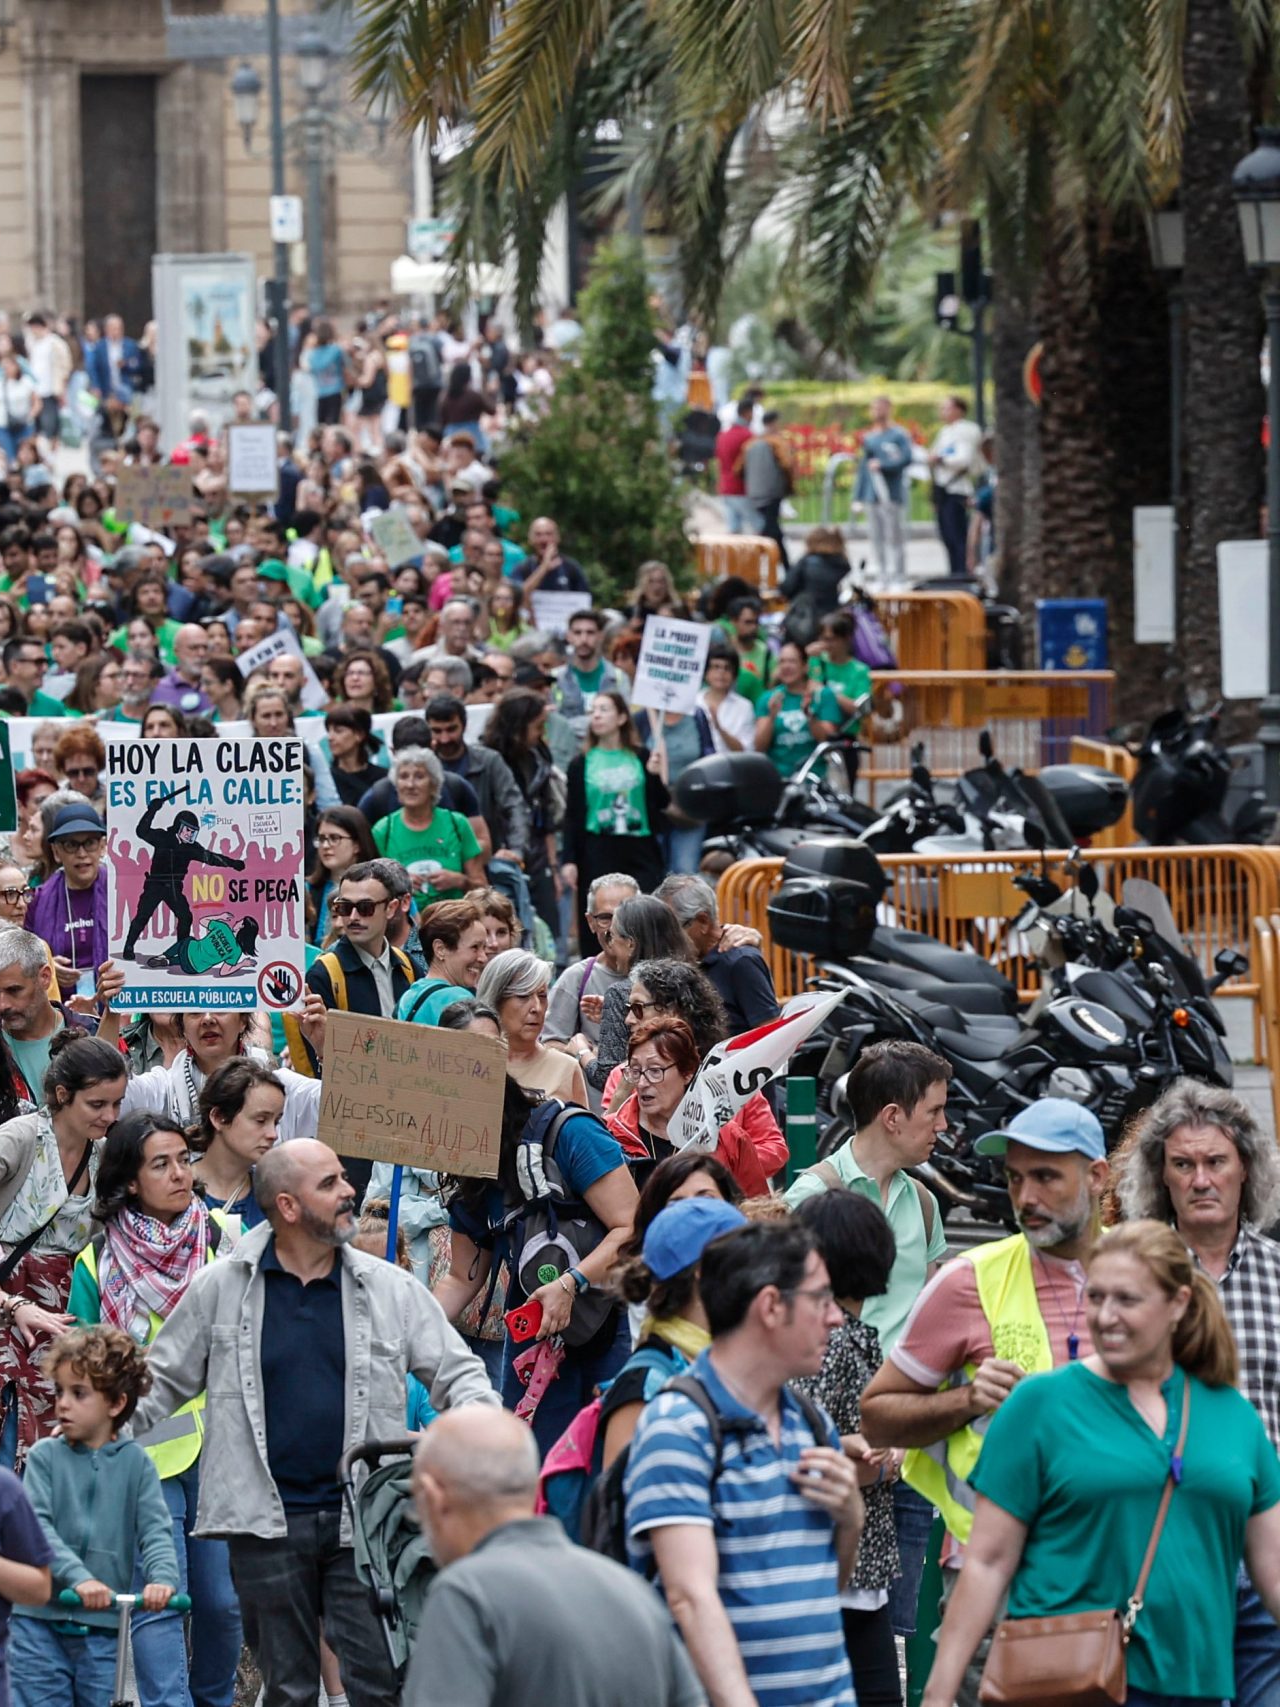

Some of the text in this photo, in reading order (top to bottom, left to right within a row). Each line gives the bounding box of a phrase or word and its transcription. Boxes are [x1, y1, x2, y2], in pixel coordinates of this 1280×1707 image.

[108, 741, 302, 776] HOY LA CLASE
[109, 778, 302, 808] ES EN LA CALLE:
[192, 873, 300, 903] NO SE PEGA
[111, 988, 243, 1005] POR LA ESCUELA PÚBLICA
[332, 1024, 491, 1081] LA MEUA MESTRA
[322, 1091, 489, 1157] NECESSITA AJUDA
